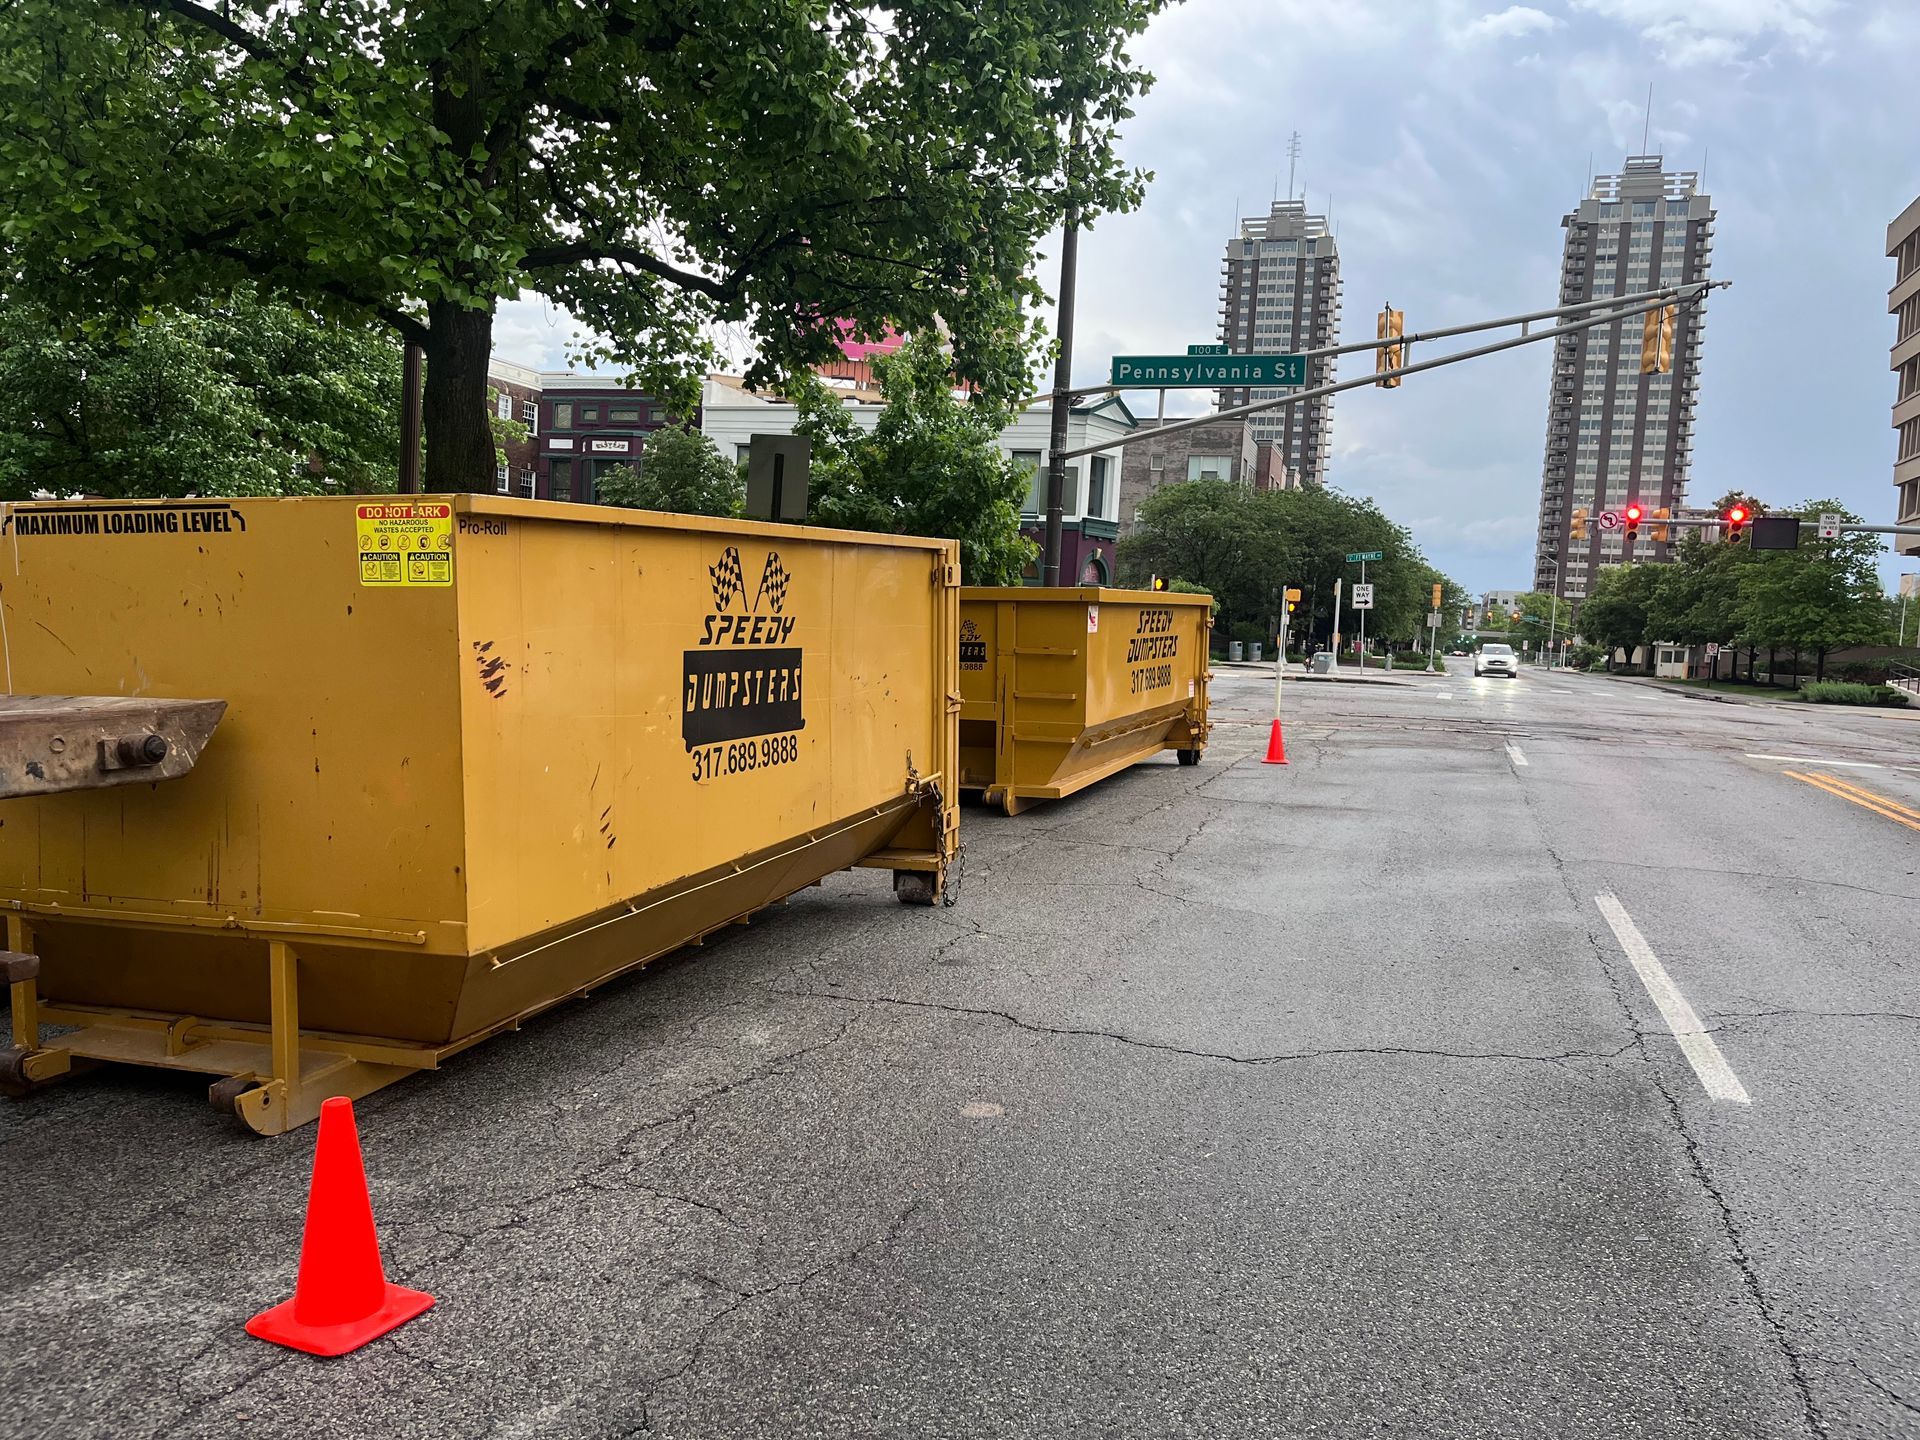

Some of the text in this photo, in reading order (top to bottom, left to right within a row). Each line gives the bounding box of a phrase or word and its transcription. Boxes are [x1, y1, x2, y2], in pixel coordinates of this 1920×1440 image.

[1194, 346, 1221, 354] 100 E
[1119, 362, 1297, 382] Pennsylvania St
[15, 511, 232, 535] MAXIMUM LOADING LEVEL
[366, 507, 382, 518] DO
[385, 507, 408, 518] NOT
[459, 519, 507, 536] Pro-Roll
[367, 553, 398, 561] CAUTION
[415, 553, 447, 561] CAUTION
[699, 615, 796, 646] SPEEDY
[1137, 610, 1174, 634] SPEEDY
[1127, 635, 1179, 663] DUMPSTERS
[686, 667, 801, 712] DUMPSTERS
[1131, 664, 1172, 694] 317.689.9888
[692, 734, 798, 782] 317.689.9888
